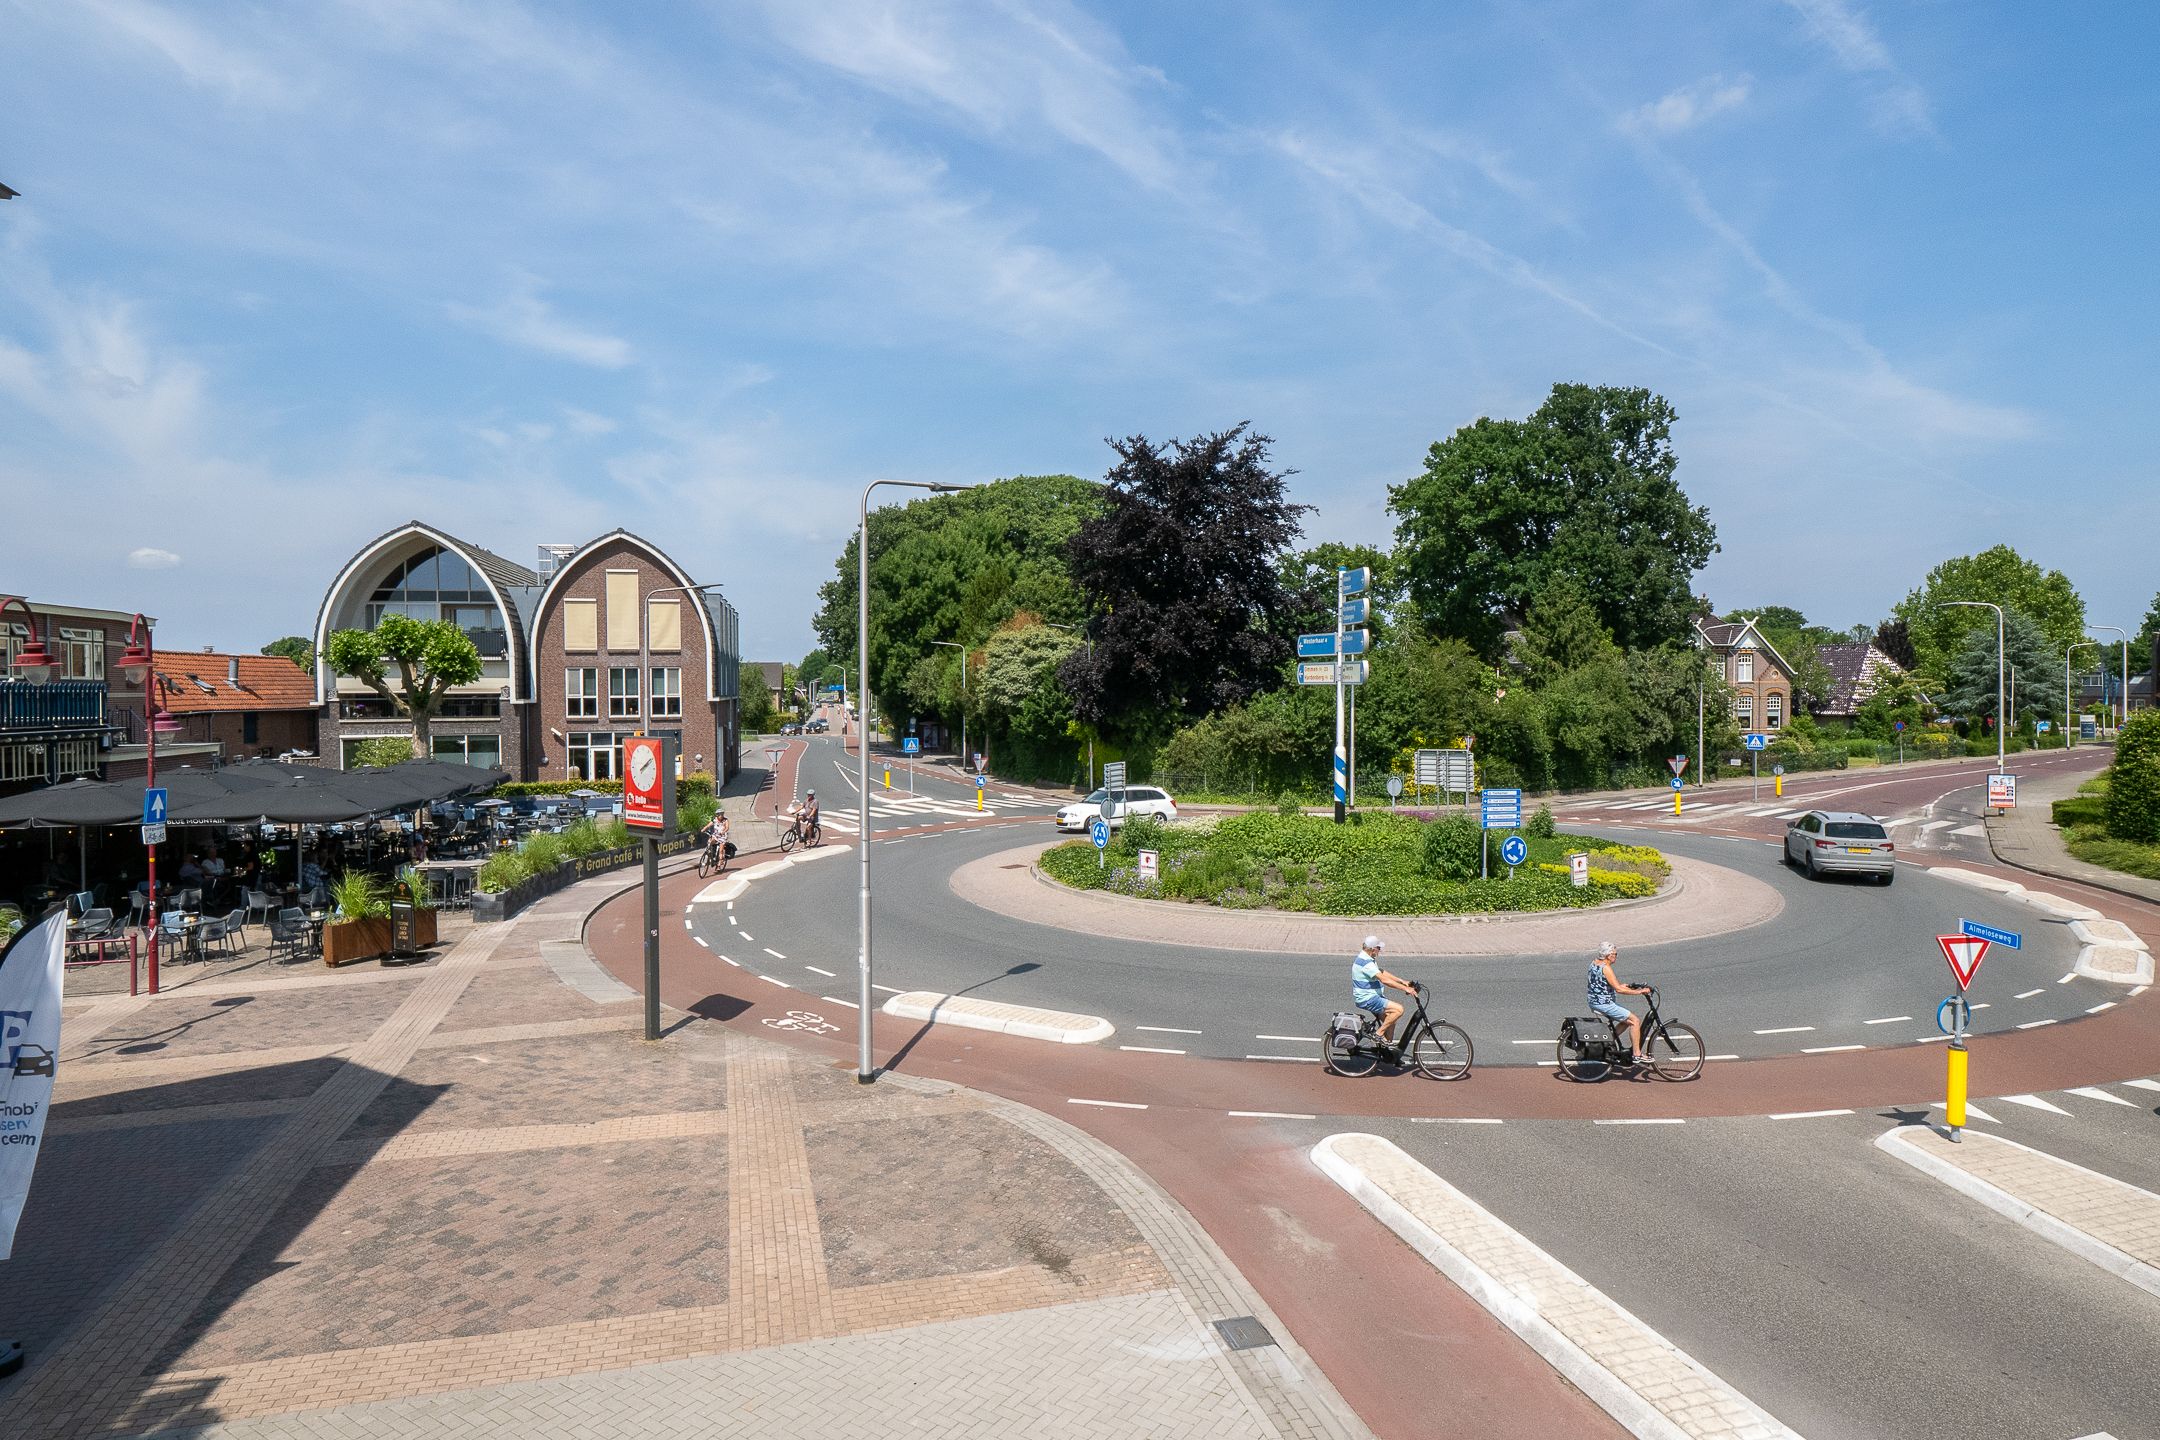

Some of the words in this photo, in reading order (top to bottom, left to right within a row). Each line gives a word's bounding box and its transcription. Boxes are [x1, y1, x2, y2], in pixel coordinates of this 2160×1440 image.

[586, 856, 611, 871] Grand
[614, 848, 633, 863] café
[1968, 924, 2012, 944] Almeloseweg
